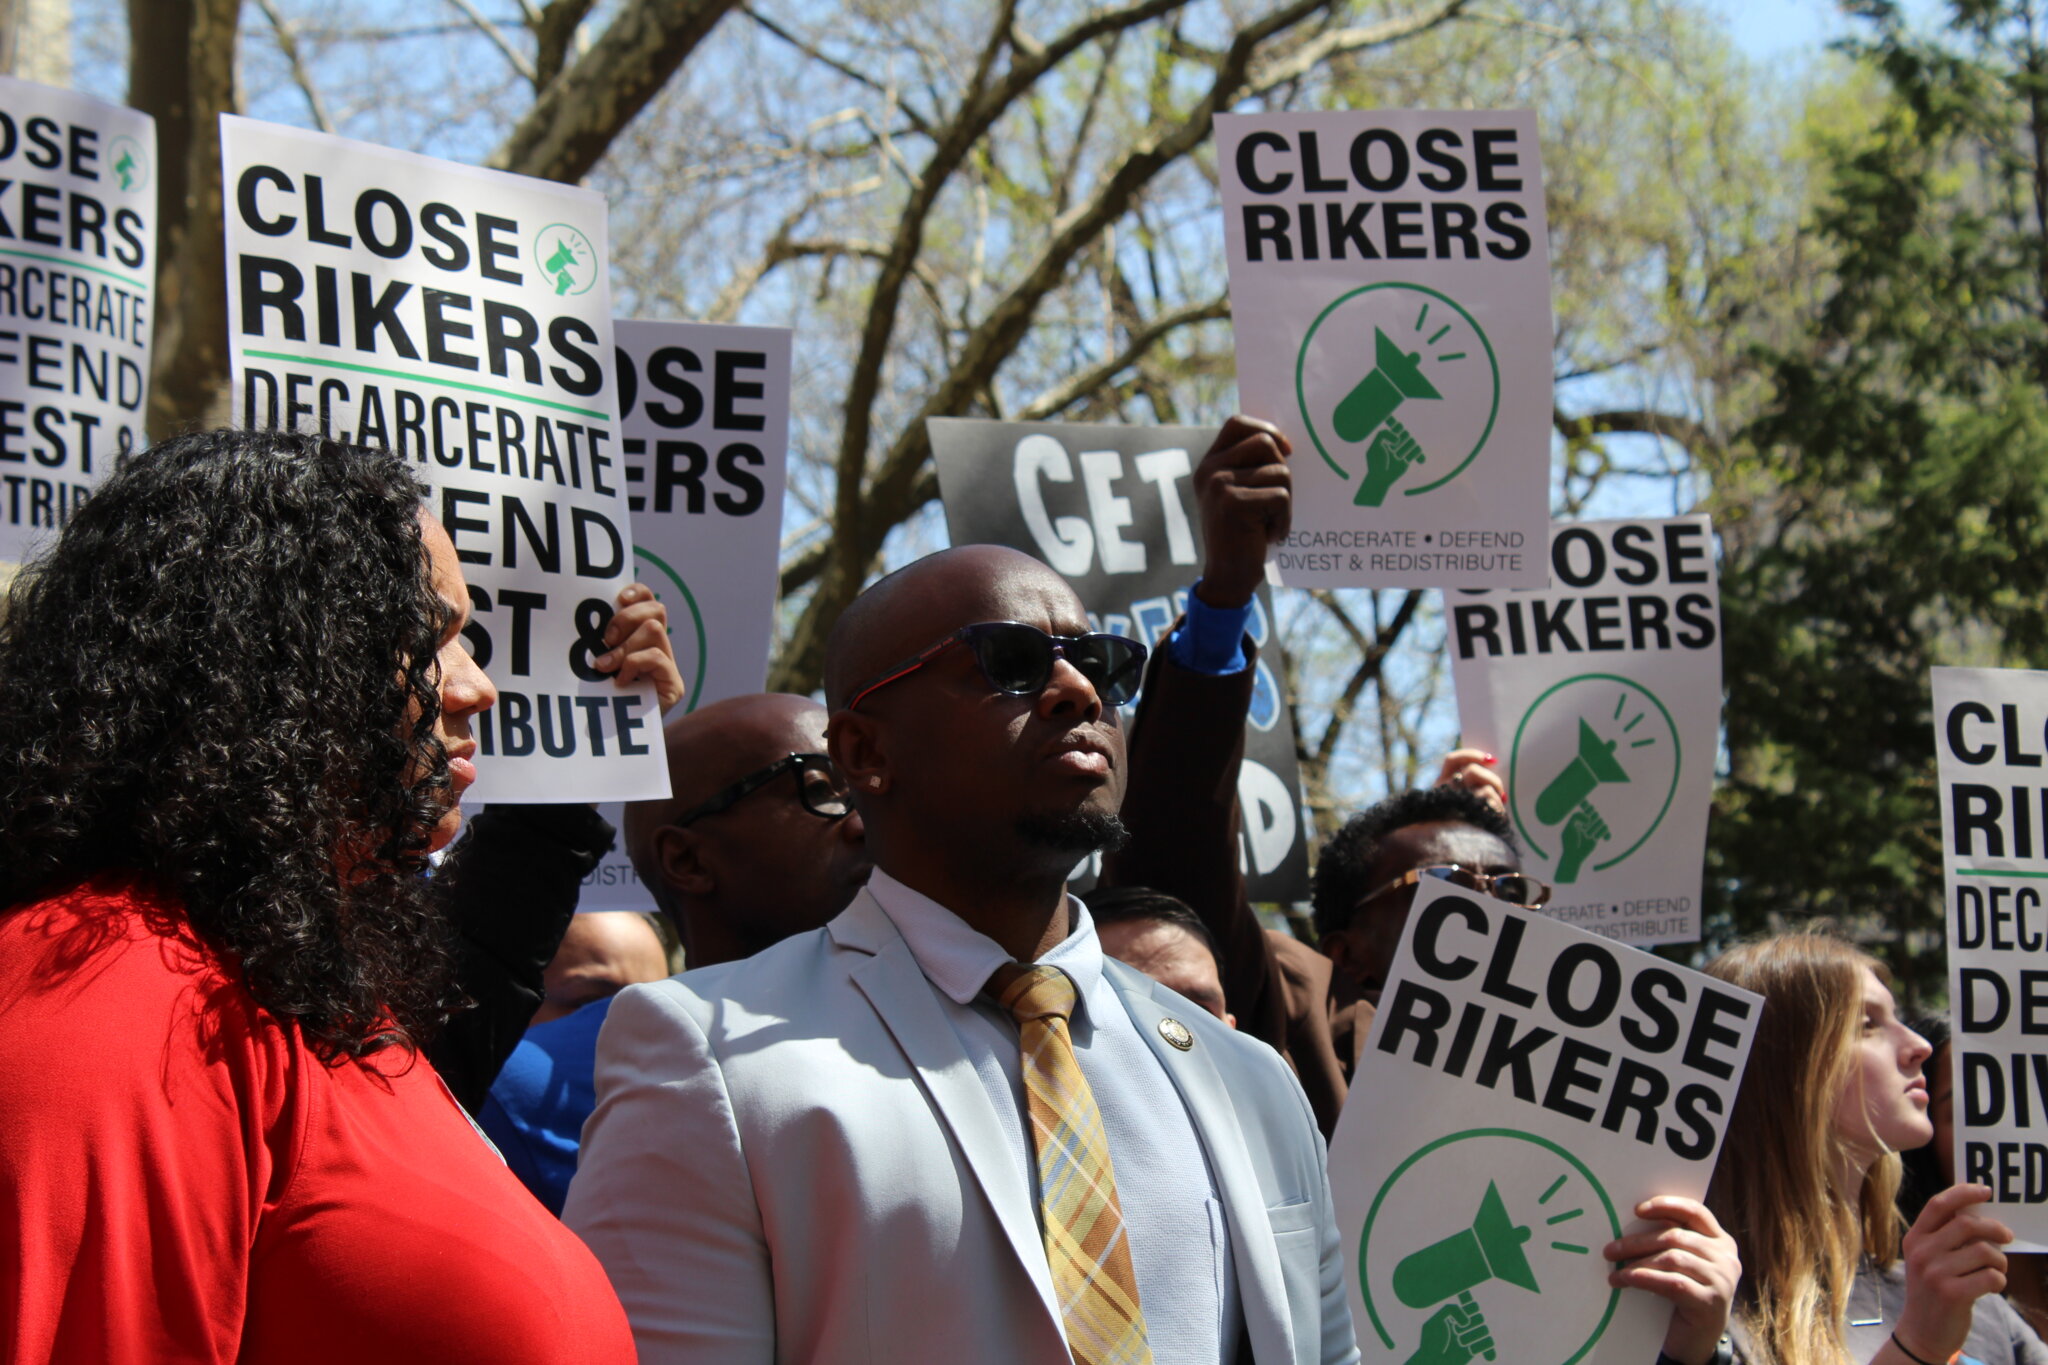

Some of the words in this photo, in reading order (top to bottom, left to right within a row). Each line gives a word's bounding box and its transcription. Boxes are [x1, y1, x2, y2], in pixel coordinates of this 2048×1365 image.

[1235, 128, 1523, 195] CLOSE
[237, 165, 523, 287] CLOSE
[1242, 201, 1531, 262] RIKERS
[239, 253, 603, 397] RIKERS
[243, 367, 616, 499] DECARCERATE
[424, 485, 625, 580] END
[1013, 434, 1197, 577] GET
[1440, 531, 1524, 548] DEFEND
[1279, 553, 1342, 571] DIVEST
[1349, 553, 1362, 571] &
[1371, 553, 1522, 571] REDISTRIBUTE
[1457, 524, 1708, 595] OSE
[1453, 593, 1716, 660] RIKERS
[470, 690, 649, 758] IBUTE
[1946, 701, 2048, 768] CL
[1951, 783, 2048, 860] RI
[1623, 897, 1691, 917] DEFEND
[1957, 885, 2048, 953] DEC
[1412, 895, 1751, 1081] CLOSE
[1377, 979, 1724, 1162] RIKERS
